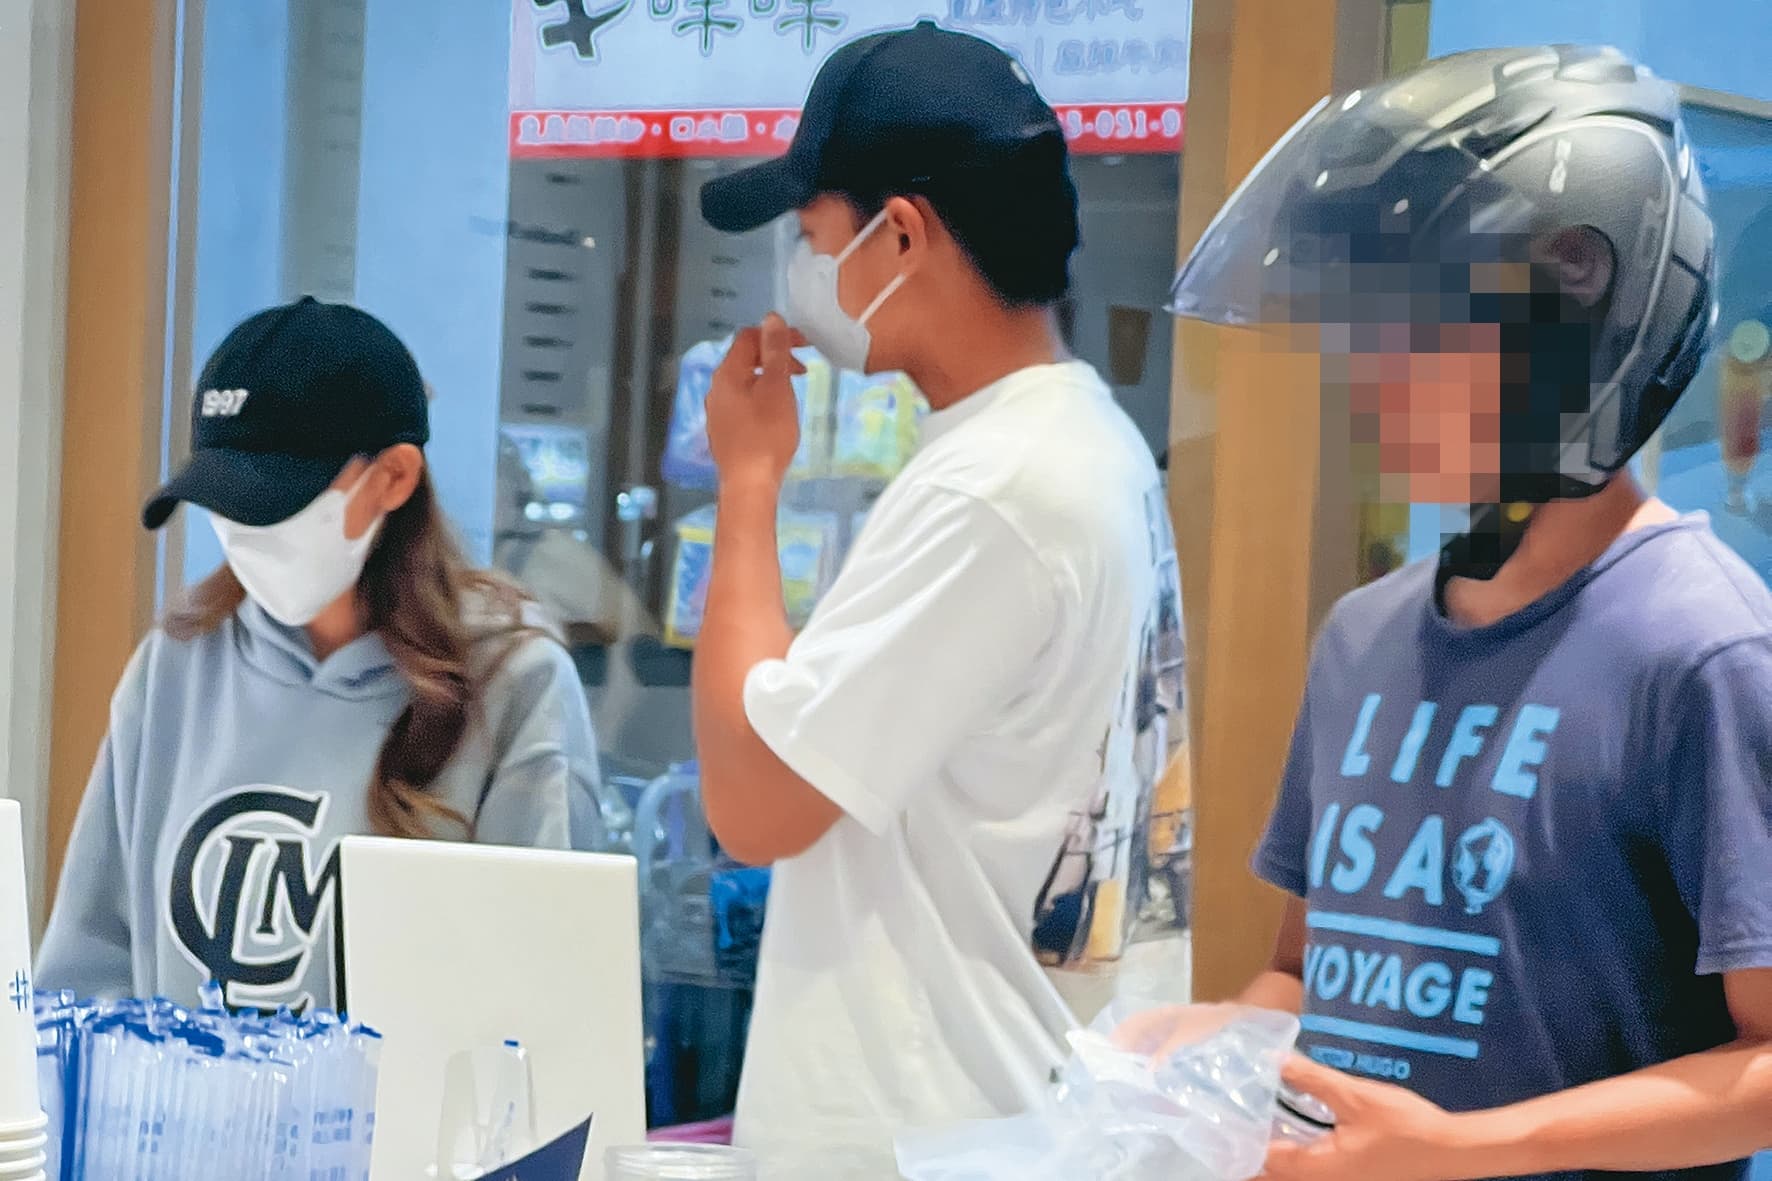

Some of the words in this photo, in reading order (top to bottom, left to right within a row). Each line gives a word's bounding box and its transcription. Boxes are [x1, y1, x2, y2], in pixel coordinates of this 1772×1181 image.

[1339, 693, 1560, 799] LIFE
[1309, 803, 1385, 894] IS
[1383, 815, 1445, 907] A
[1303, 944, 1494, 1026] VOYAGE
